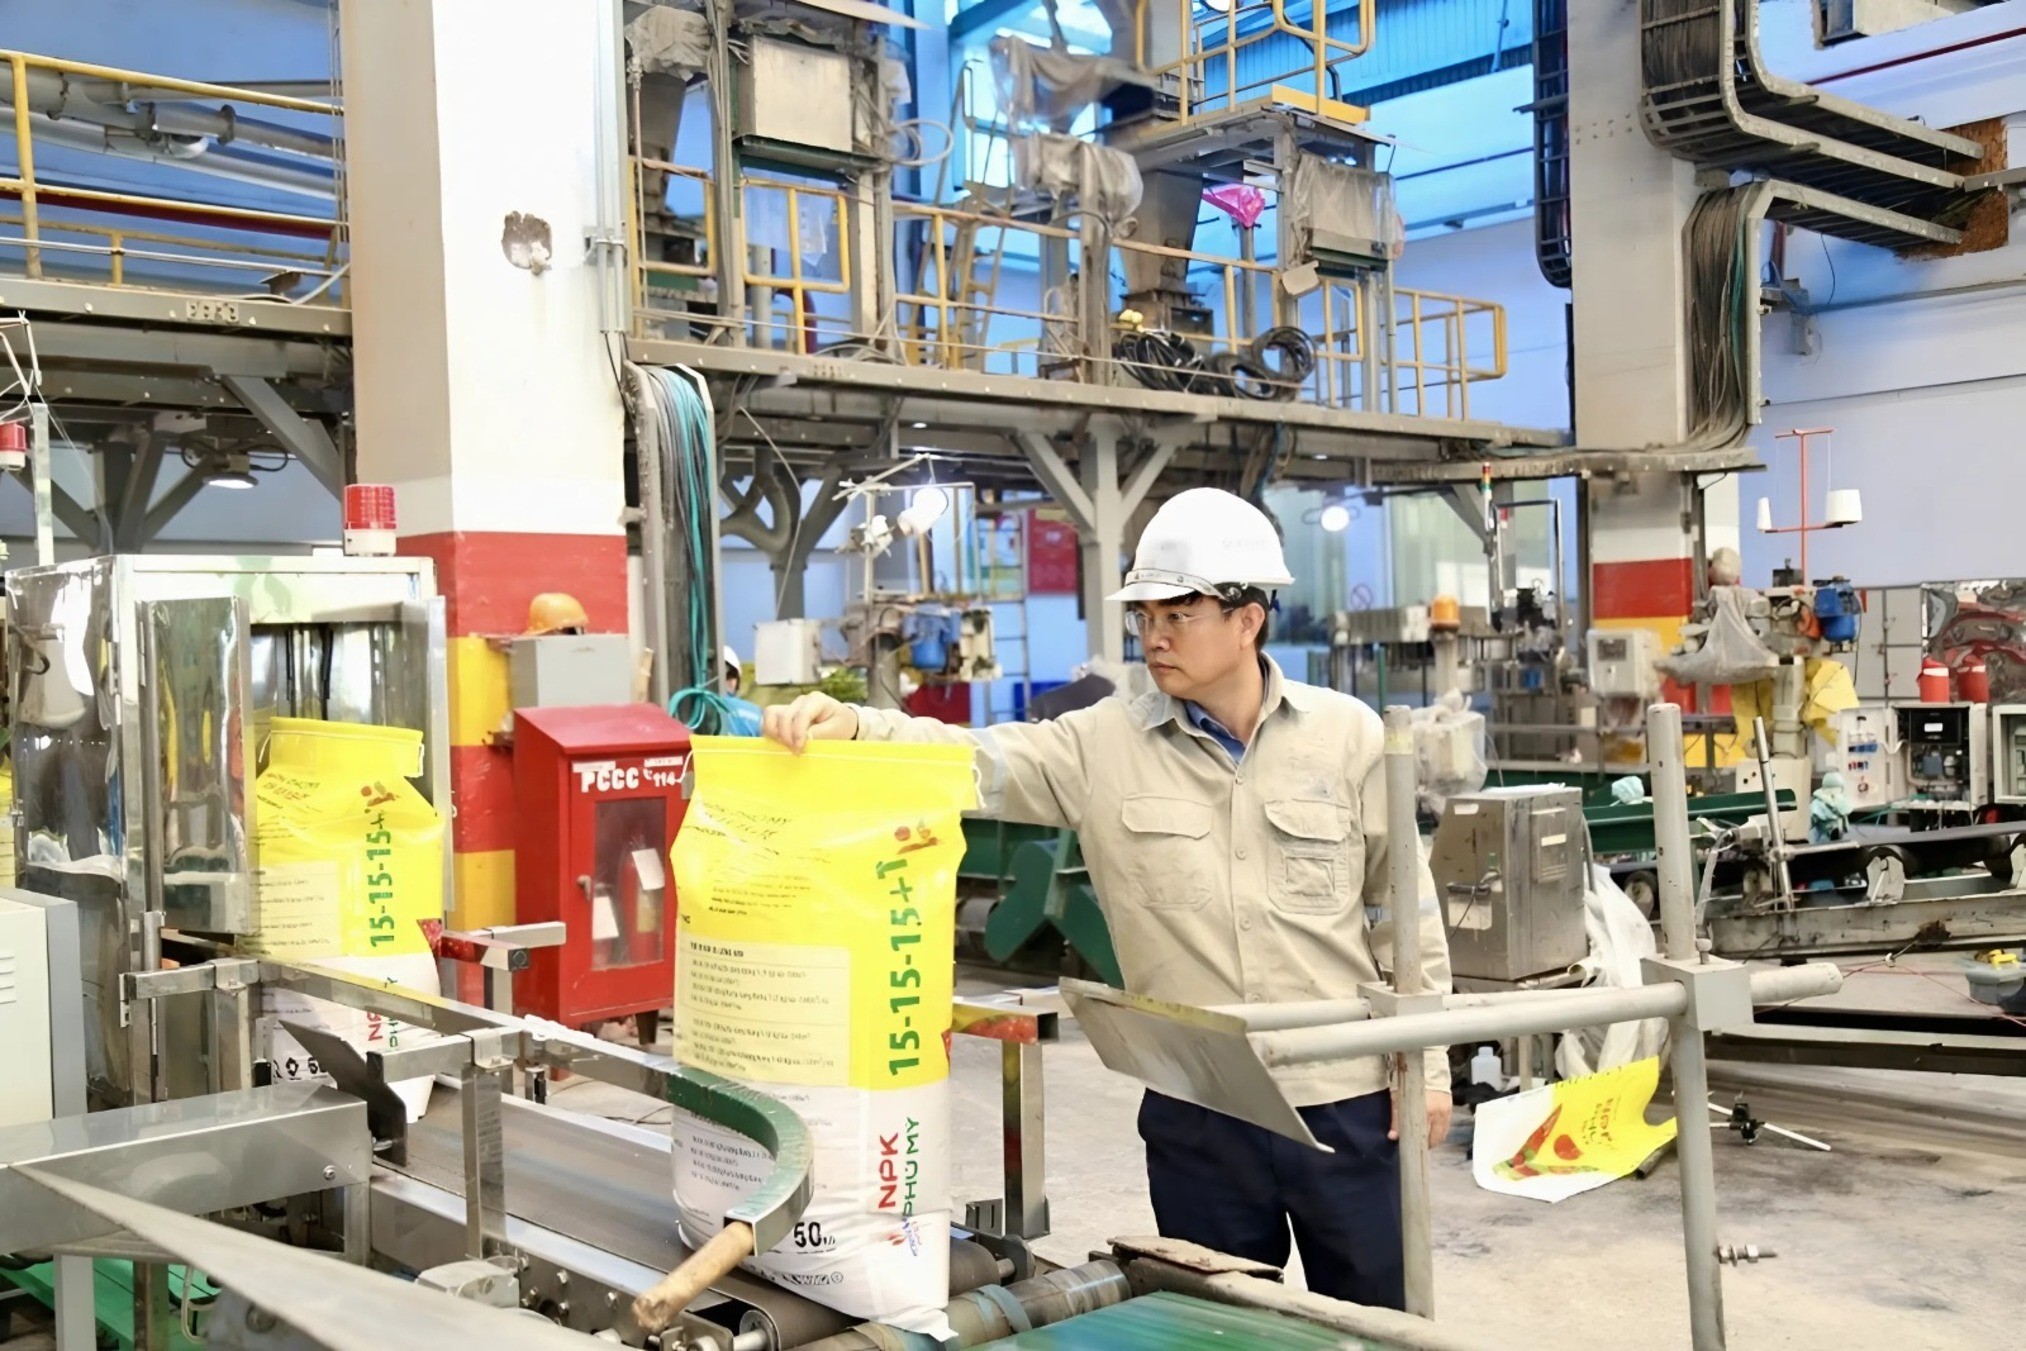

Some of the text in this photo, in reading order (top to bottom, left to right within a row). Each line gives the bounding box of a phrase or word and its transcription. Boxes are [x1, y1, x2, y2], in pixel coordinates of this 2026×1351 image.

[580, 767, 676, 793] PCCC 114
[875, 858, 922, 1076] 15-15-15+1
[878, 1132, 899, 1209] NPK
